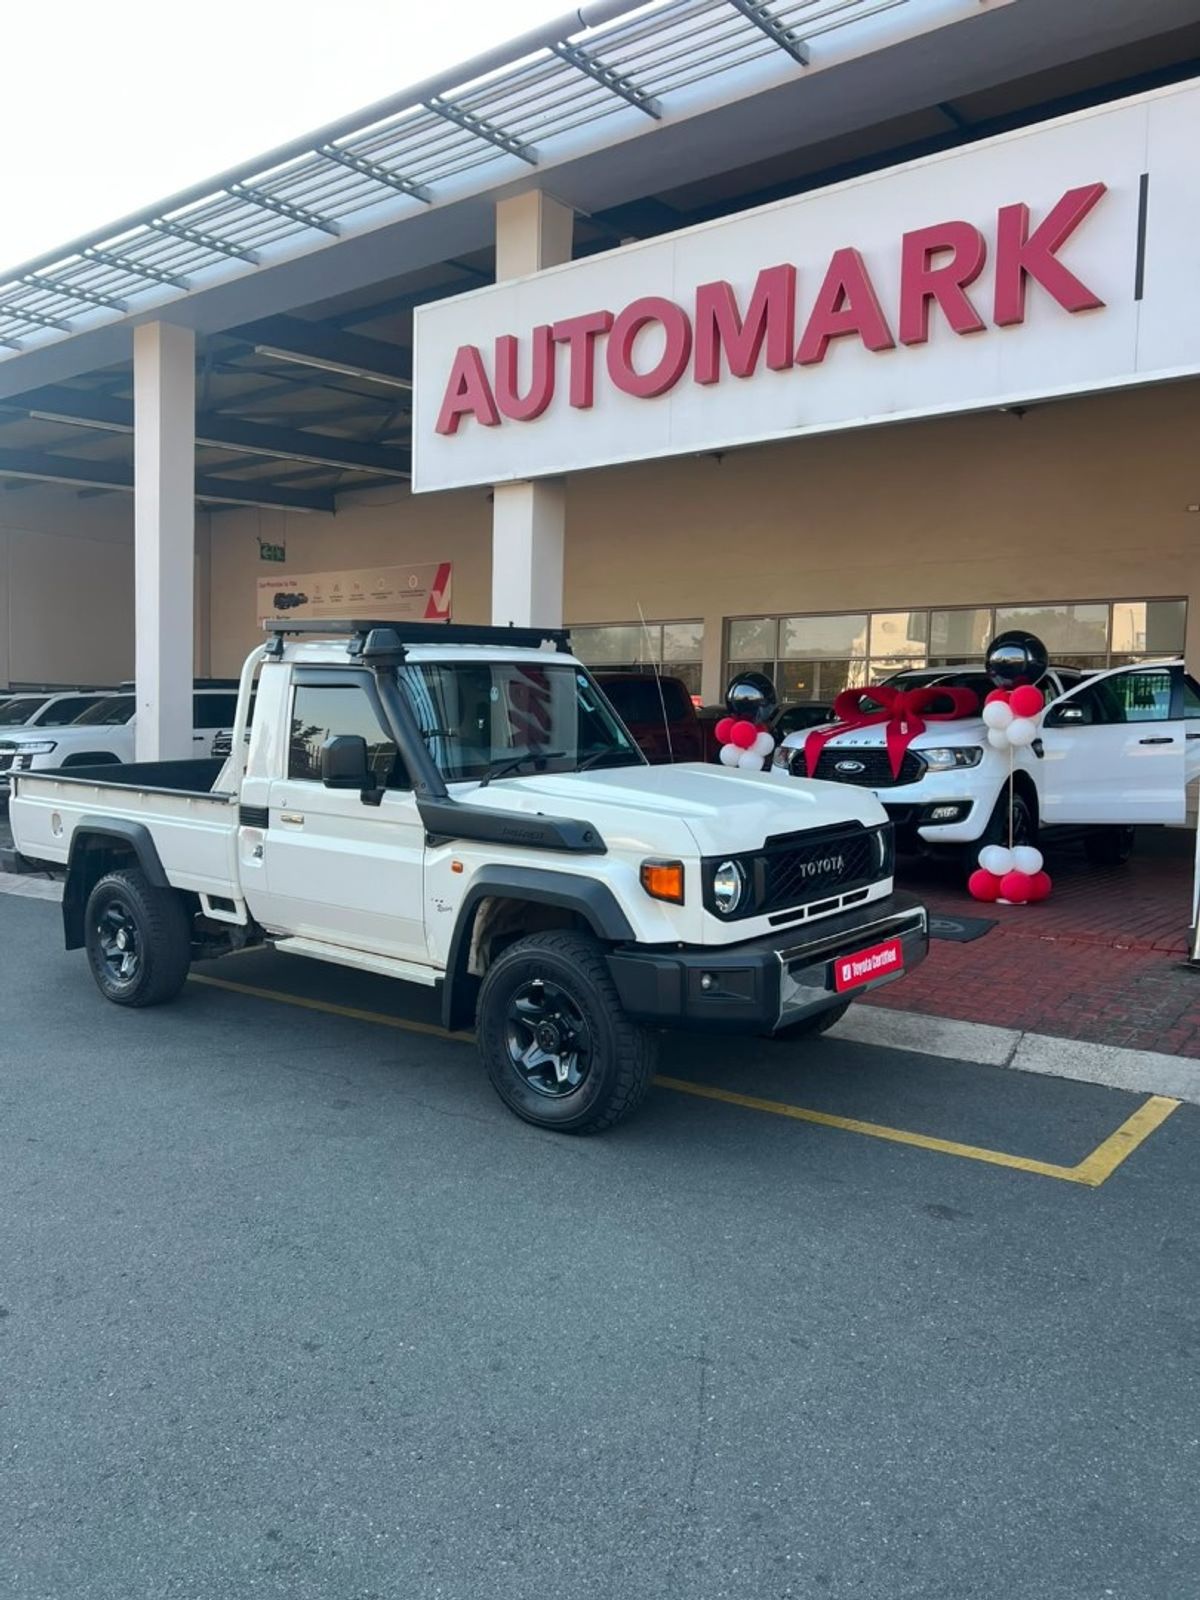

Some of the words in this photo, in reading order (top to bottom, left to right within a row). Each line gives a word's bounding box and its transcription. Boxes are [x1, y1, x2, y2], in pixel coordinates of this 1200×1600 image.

[435, 182, 1107, 435] AUTOMARK
[799, 855, 845, 878] TOYOTA
[851, 957, 873, 977] Toyota
[872, 947, 897, 971] Certified
